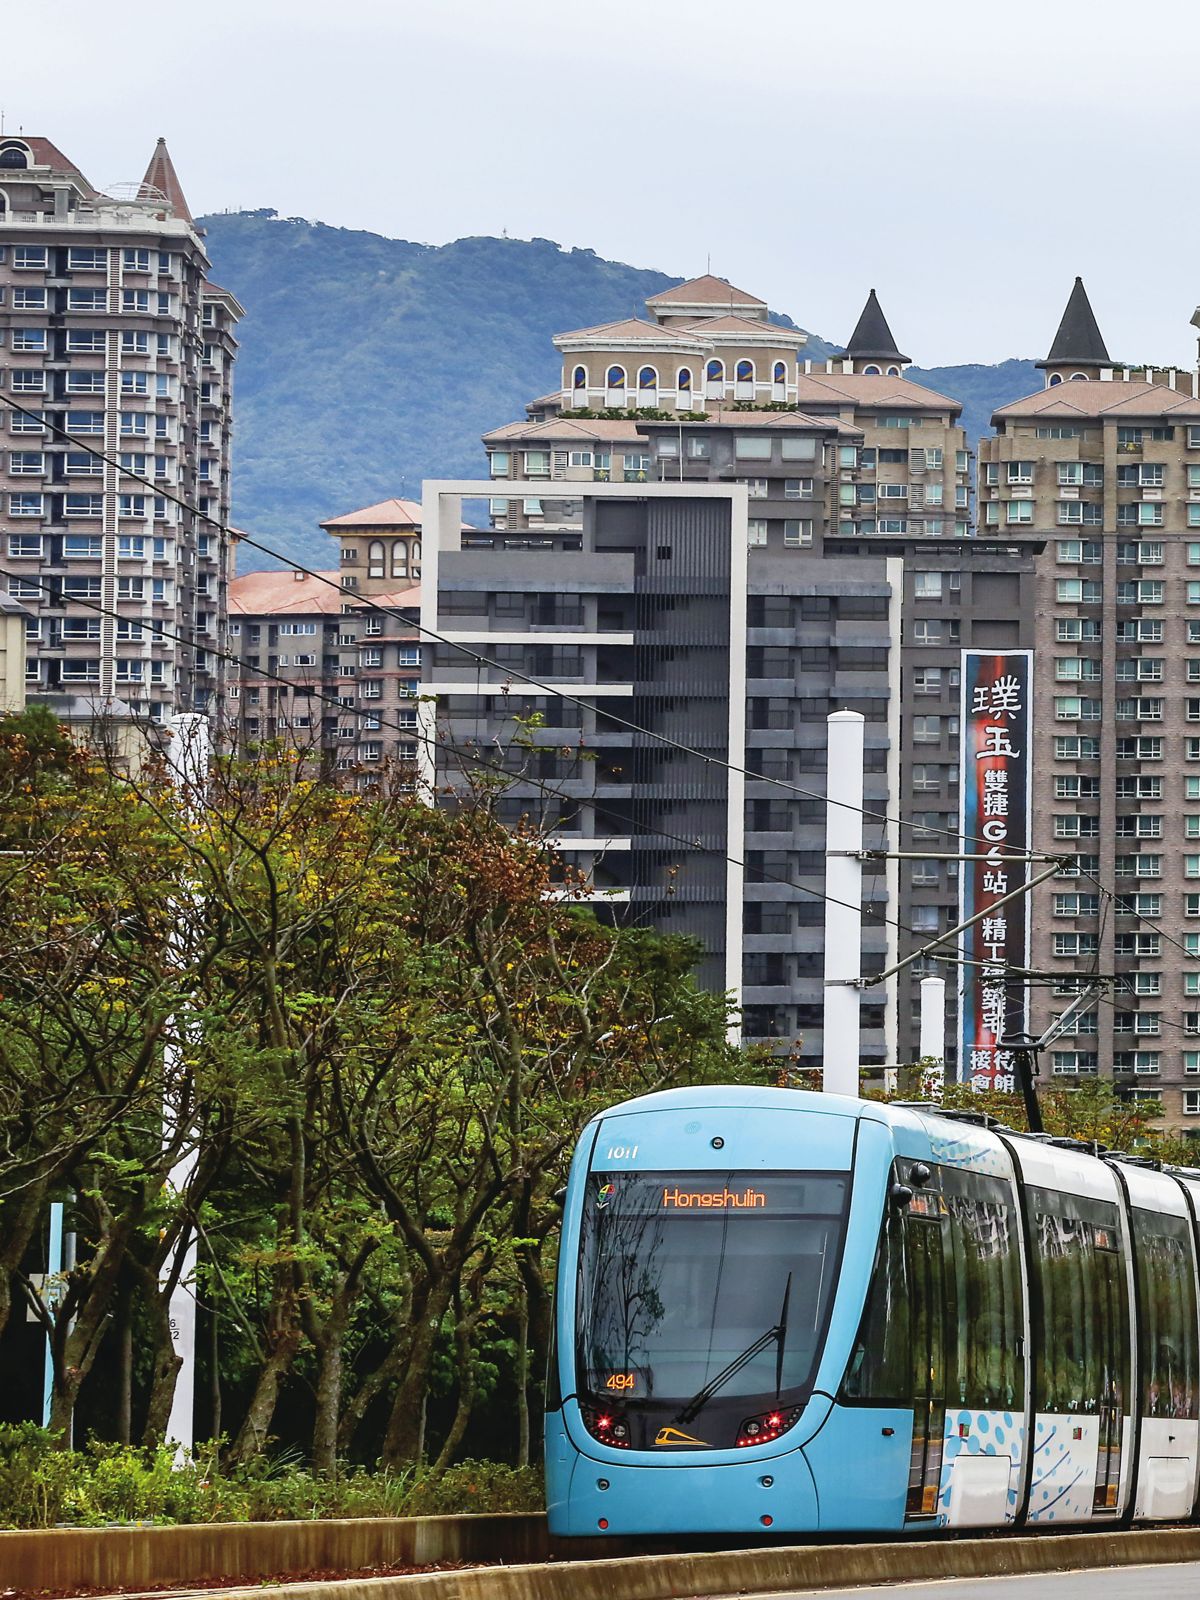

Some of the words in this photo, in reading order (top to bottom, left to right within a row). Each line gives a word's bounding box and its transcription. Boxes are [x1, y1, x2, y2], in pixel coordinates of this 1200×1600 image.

[971, 675, 1021, 760] 璞玉
[663, 1187, 765, 1208] Hongshulin
[606, 1373, 634, 1389] 494
